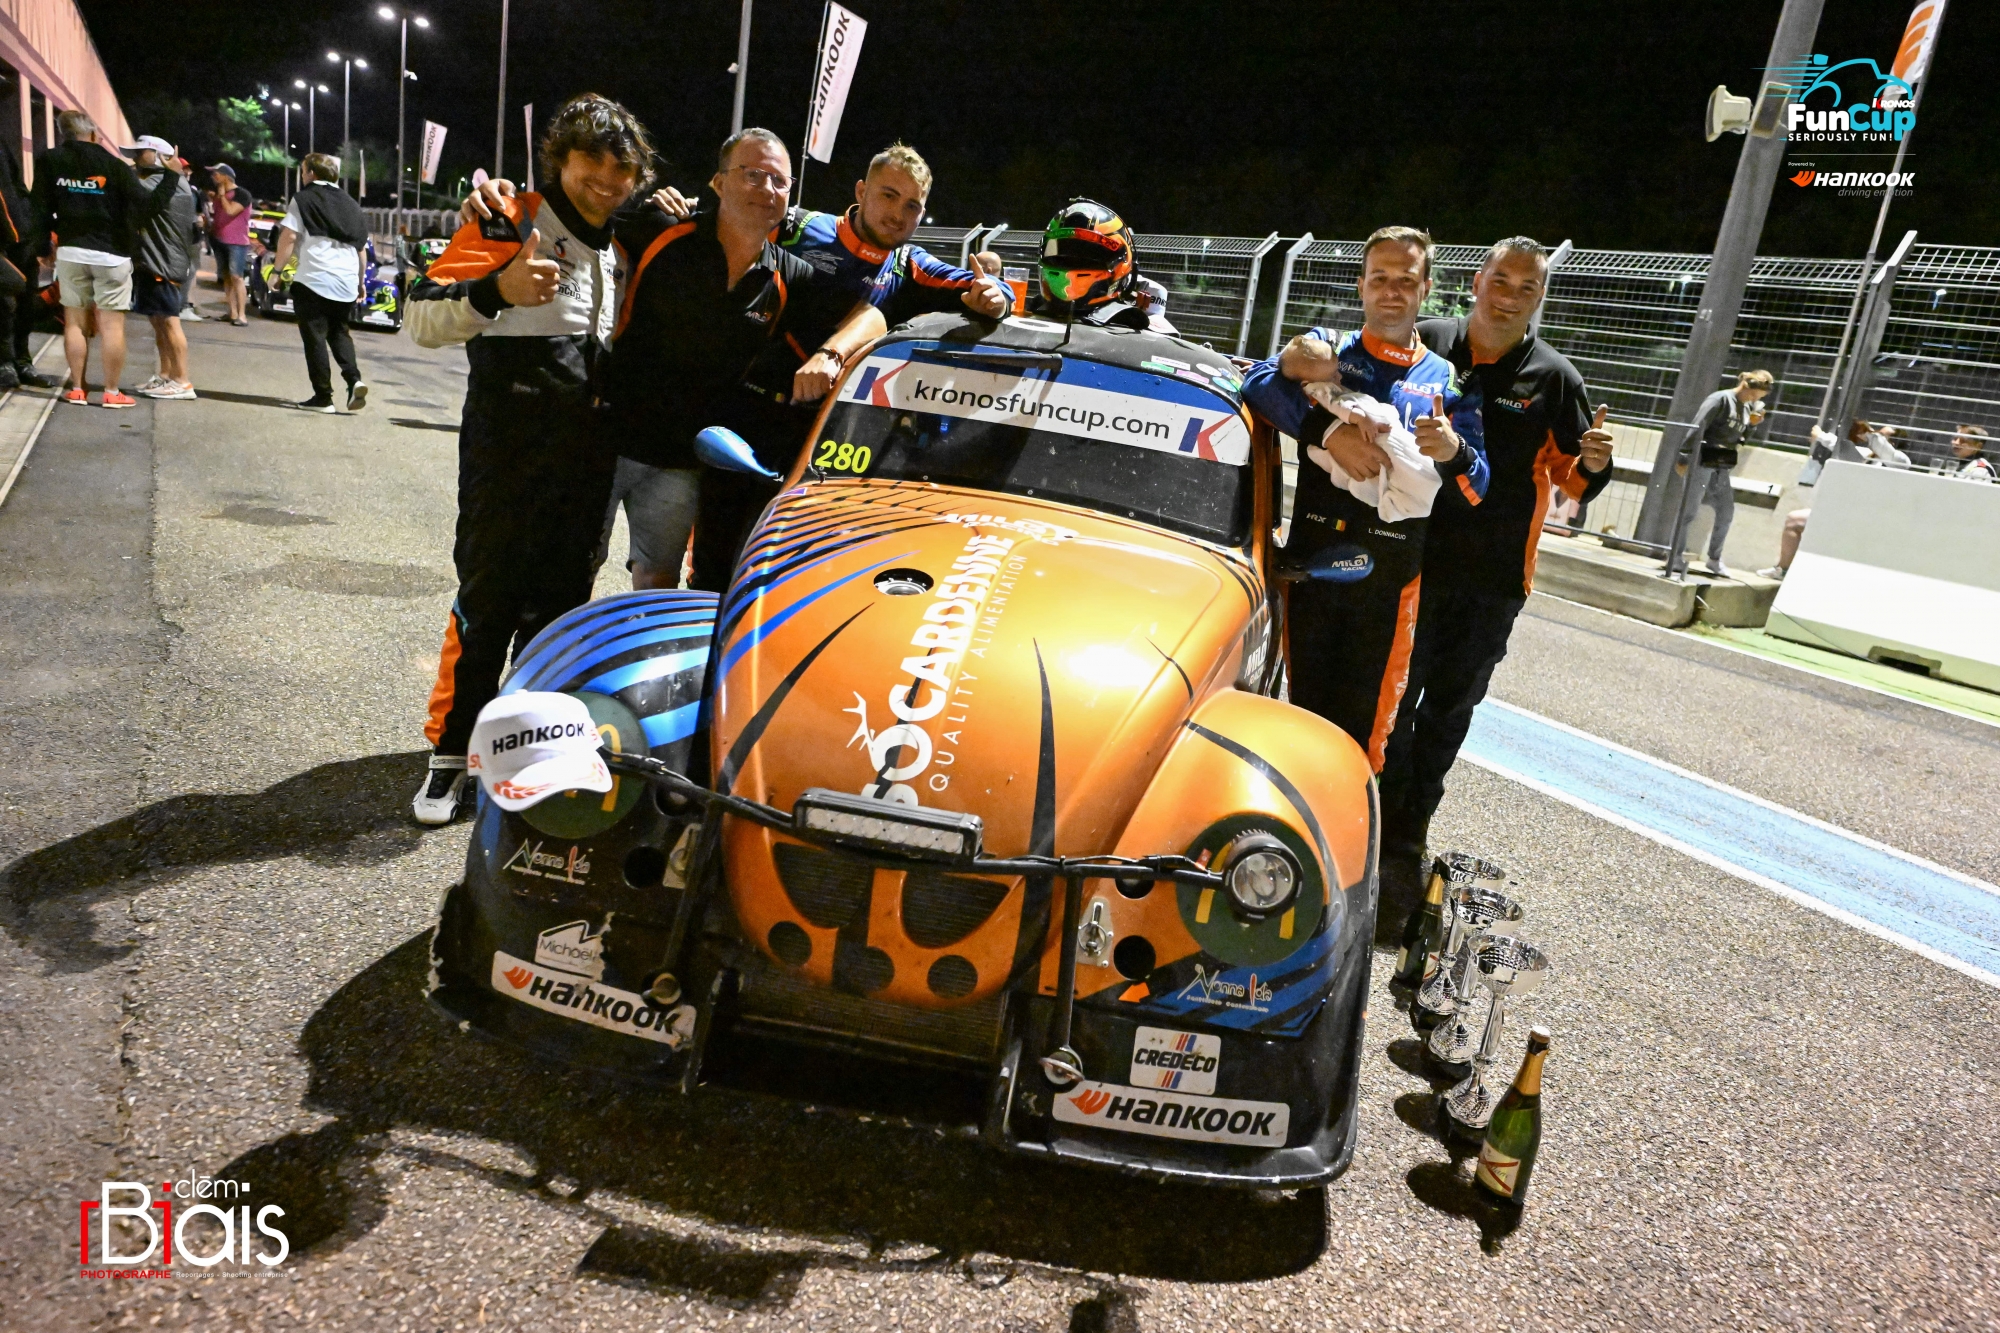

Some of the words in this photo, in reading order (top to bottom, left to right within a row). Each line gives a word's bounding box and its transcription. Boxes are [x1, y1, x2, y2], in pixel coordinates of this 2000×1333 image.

[914, 379, 1170, 439] kronosfuncup.com
[815, 440, 871, 473] 280
[1306, 513, 1327, 523] HRX
[1332, 559, 1363, 568] MILO
[929, 671, 977, 792] QUALITY
[970, 555, 1028, 659] ALIMENTATION
[1177, 965, 1245, 1000] Nonna
[1134, 1048, 1217, 1073] CREDECO
